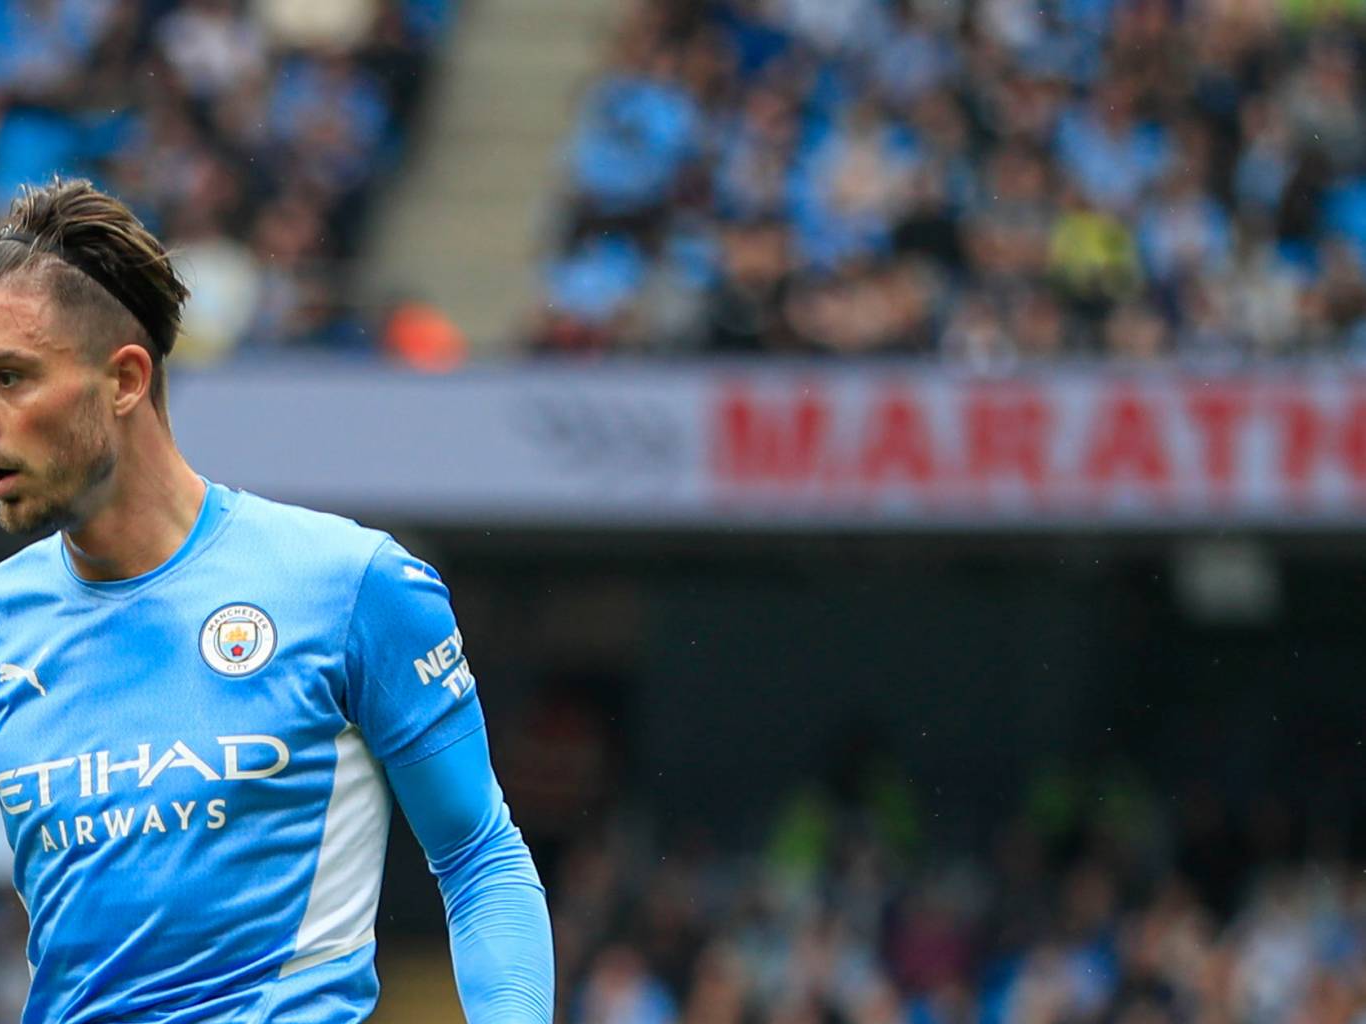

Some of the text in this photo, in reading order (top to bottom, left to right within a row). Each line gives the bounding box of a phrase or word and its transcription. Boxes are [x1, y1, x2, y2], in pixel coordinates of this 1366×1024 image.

[208, 608, 269, 632] MANCHESTER
[226, 663, 250, 672] CITY
[40, 799, 227, 853] AIRWAYS
